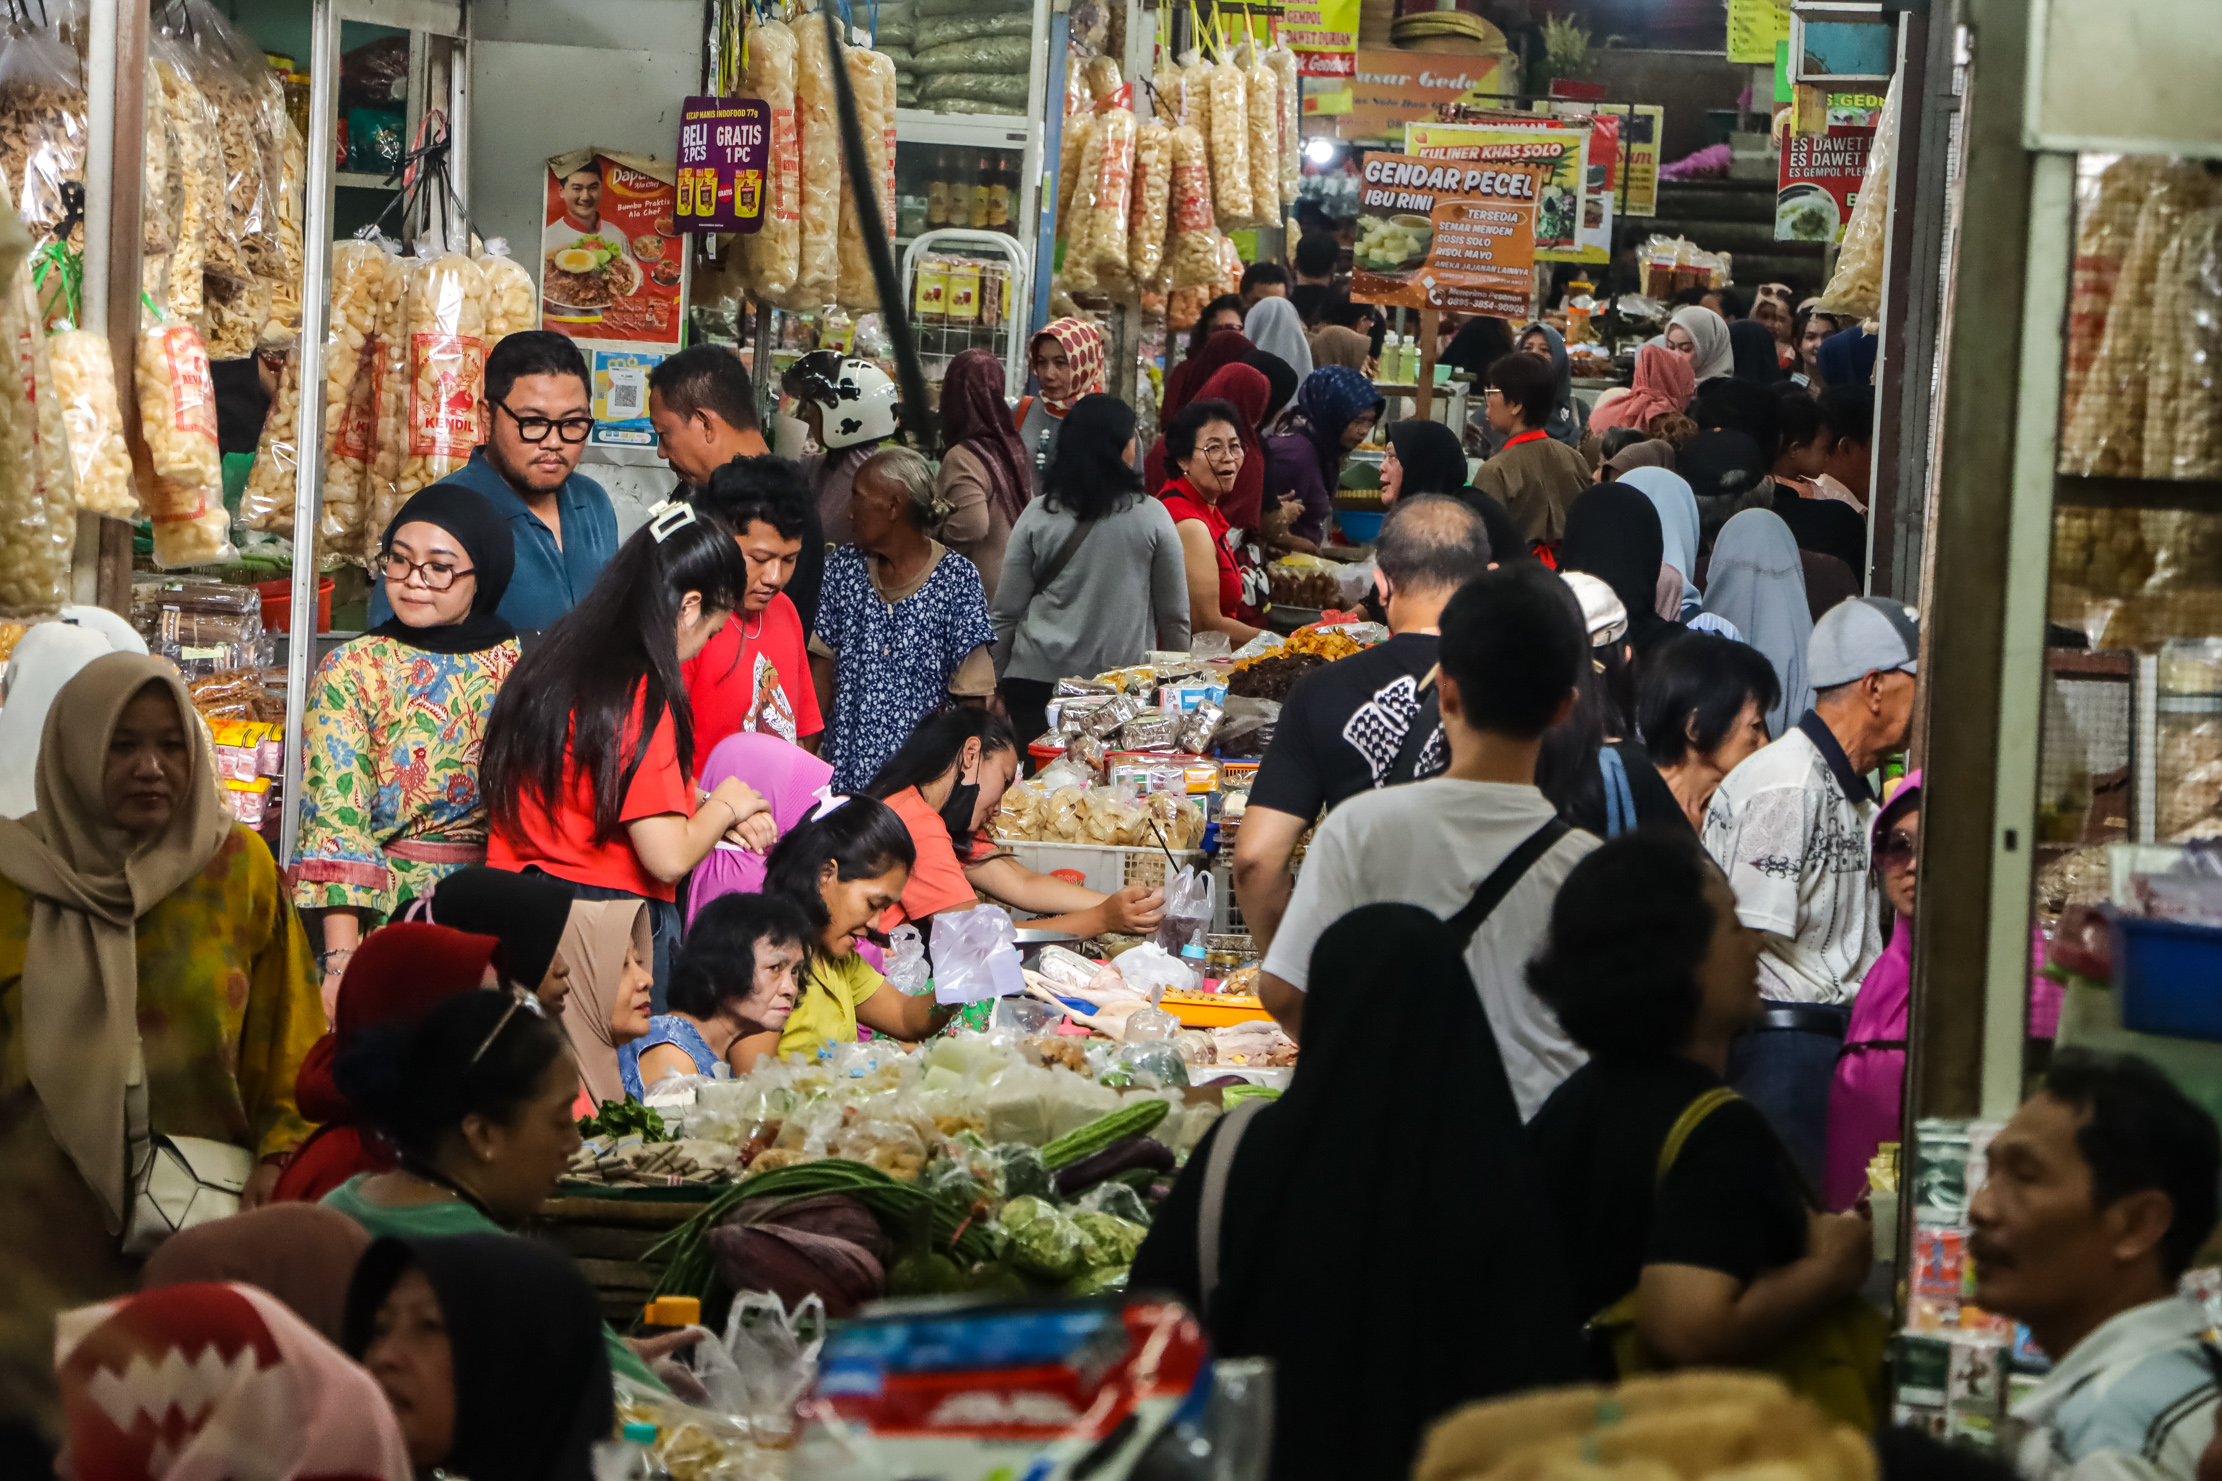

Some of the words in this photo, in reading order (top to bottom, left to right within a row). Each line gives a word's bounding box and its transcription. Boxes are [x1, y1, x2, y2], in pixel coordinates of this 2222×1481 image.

[717, 109, 746, 118] INDOFOOD
[747, 109, 759, 119] 77g
[683, 123, 708, 148] BELI
[716, 125, 762, 147] GRATIS
[1418, 147, 1479, 160] KULINER
[1481, 145, 1520, 159] KHAS
[1522, 143, 1563, 158] SOLO
[1791, 137, 1809, 152] ES
[1813, 137, 1864, 152] DAWET
[684, 148, 689, 163] 2
[689, 146, 707, 162] PCS
[734, 147, 751, 163] PC
[1790, 152, 1807, 167] ES
[1811, 152, 1862, 167] DAWET
[1365, 161, 1460, 190] GENDAR
[1463, 170, 1533, 197] PECEL
[1789, 168, 1801, 178] ES
[1803, 168, 1841, 178] GEMPOL
[617, 201, 643, 211] Bumbu
[644, 198, 671, 208] Praktis
[1365, 189, 1396, 207] IBU
[1397, 192, 1434, 211] RINI
[629, 210, 641, 218] Ala
[643, 207, 662, 217] Chef
[1468, 209, 1518, 223] TERSEDIA
[1439, 221, 1471, 233] SEMAR
[1472, 223, 1514, 236] MENDEM
[1437, 234, 1466, 245] SOSIS
[1466, 236, 1492, 248] SOLO
[1435, 247, 1463, 258] RISOL
[1464, 249, 1493, 260] MAYO
[1434, 260, 1461, 270] ANEKA
[1461, 262, 1497, 274] JAJANAN
[1497, 265, 1530, 276] LAINNYA
[425, 417, 474, 433] KENDIL
